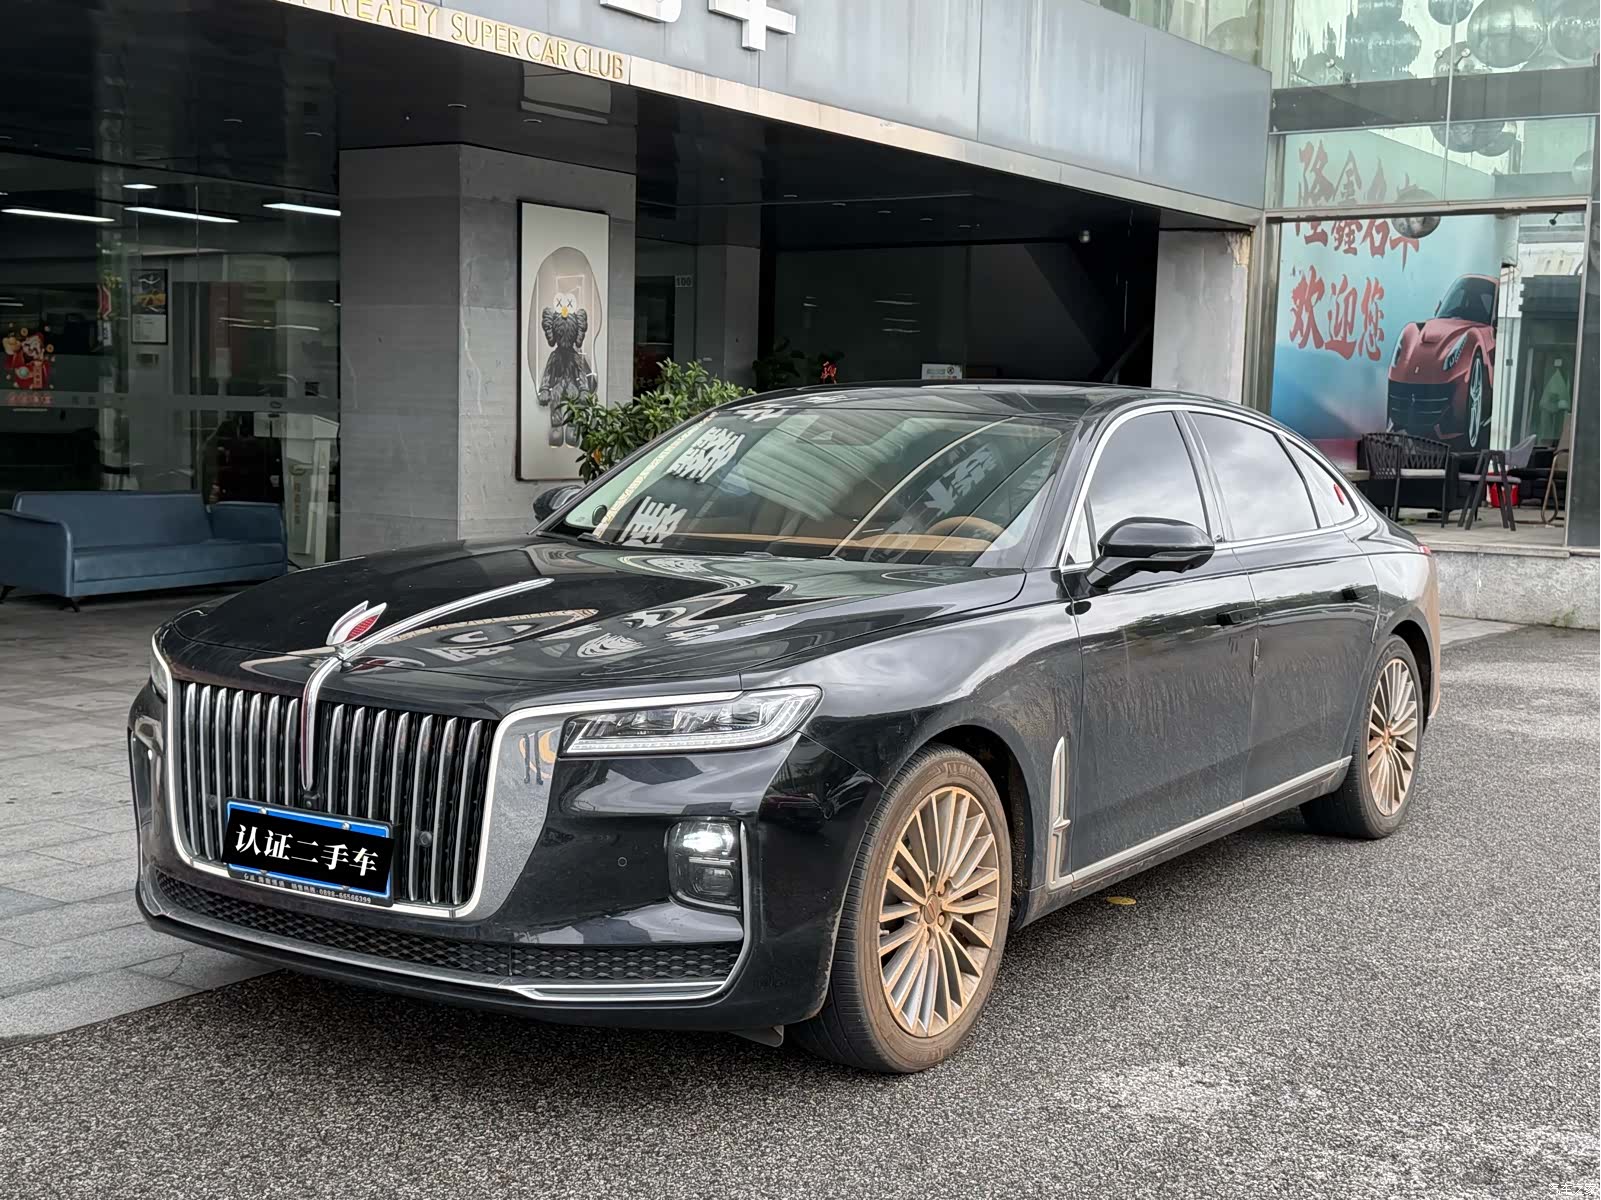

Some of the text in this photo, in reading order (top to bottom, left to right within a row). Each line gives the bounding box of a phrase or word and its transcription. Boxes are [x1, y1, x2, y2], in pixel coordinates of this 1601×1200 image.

[451, 12, 521, 56] SUPER
[527, 33, 568, 68] CAR
[574, 46, 624, 80] CLUB
[1289, 264, 1385, 361] 欢迎您
